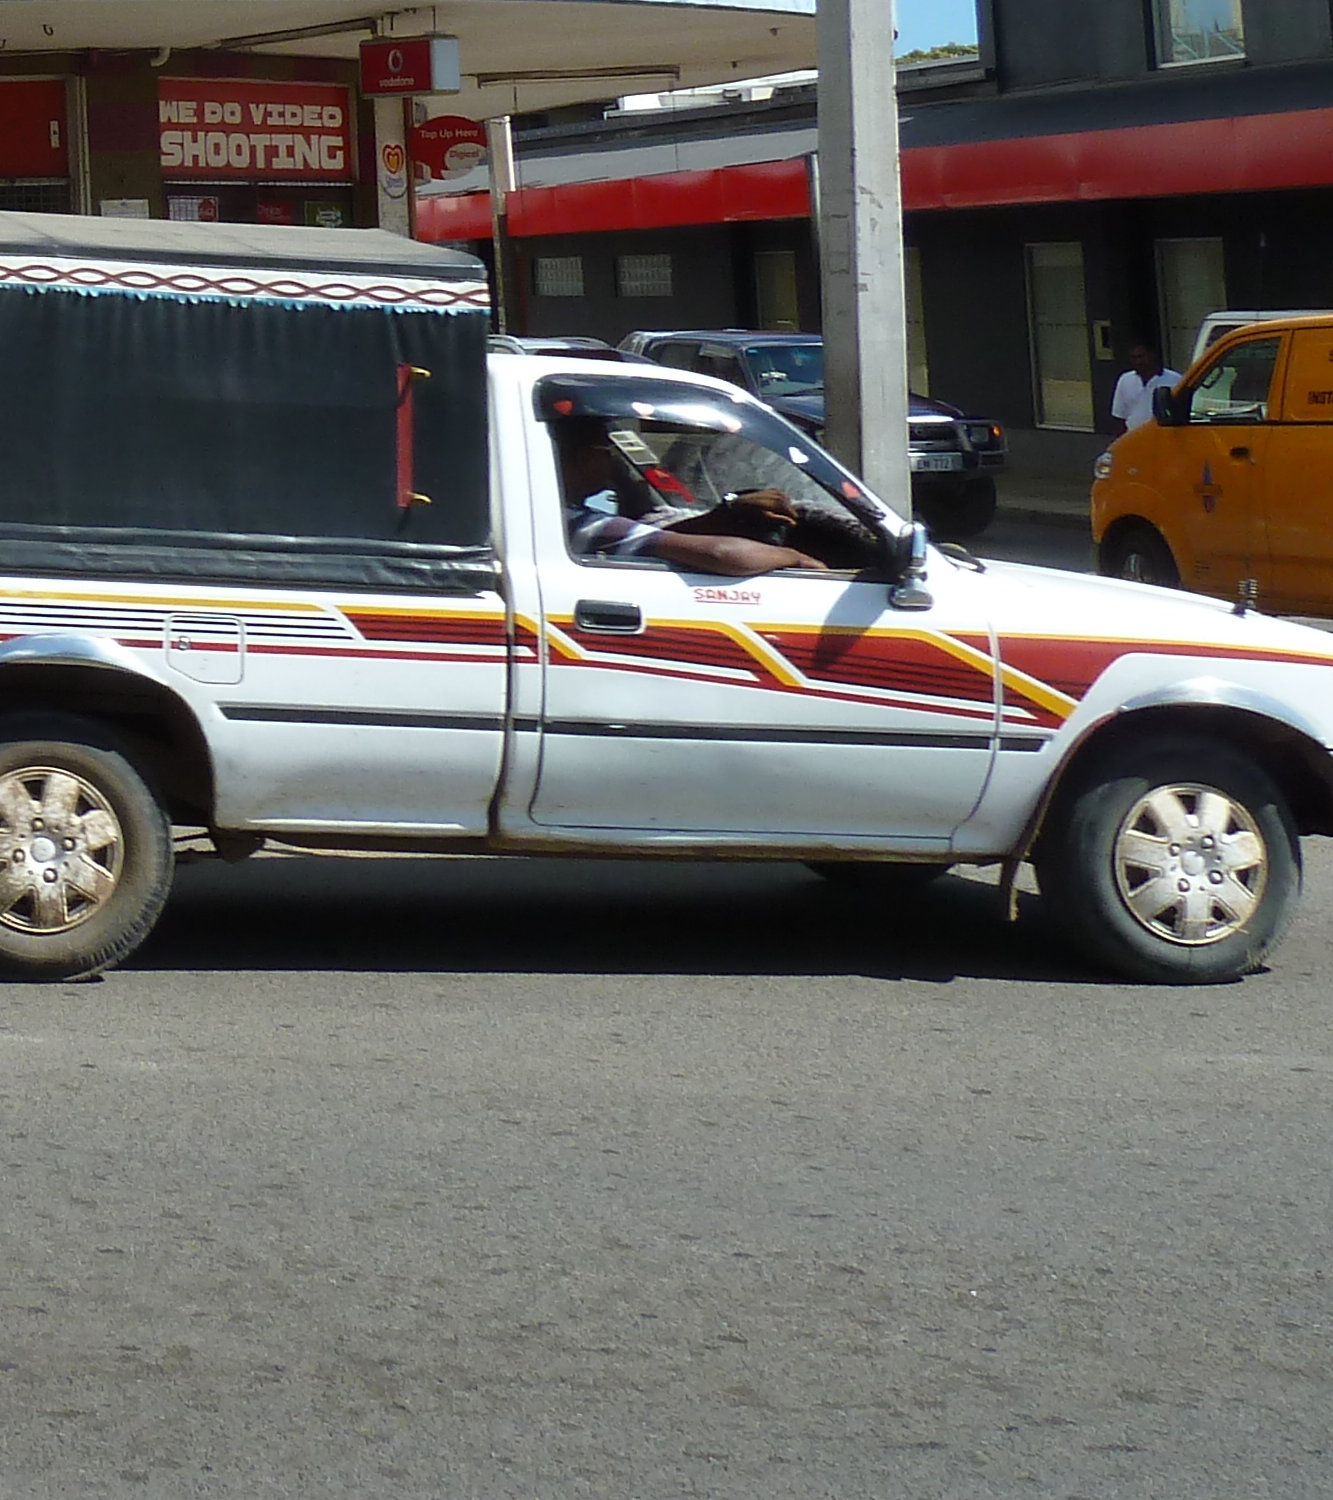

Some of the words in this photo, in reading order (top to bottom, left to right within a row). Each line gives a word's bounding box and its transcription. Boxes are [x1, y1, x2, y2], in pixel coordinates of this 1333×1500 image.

[378, 75, 416, 88] vodafone
[158, 100, 198, 124] WE
[204, 101, 242, 125] DO
[248, 103, 343, 128] VIDEO
[419, 129, 438, 140] Top
[439, 129, 454, 139] Up
[455, 129, 479, 139] Here
[160, 130, 345, 170] SHOOTING
[694, 588, 762, 604] SANJAY
